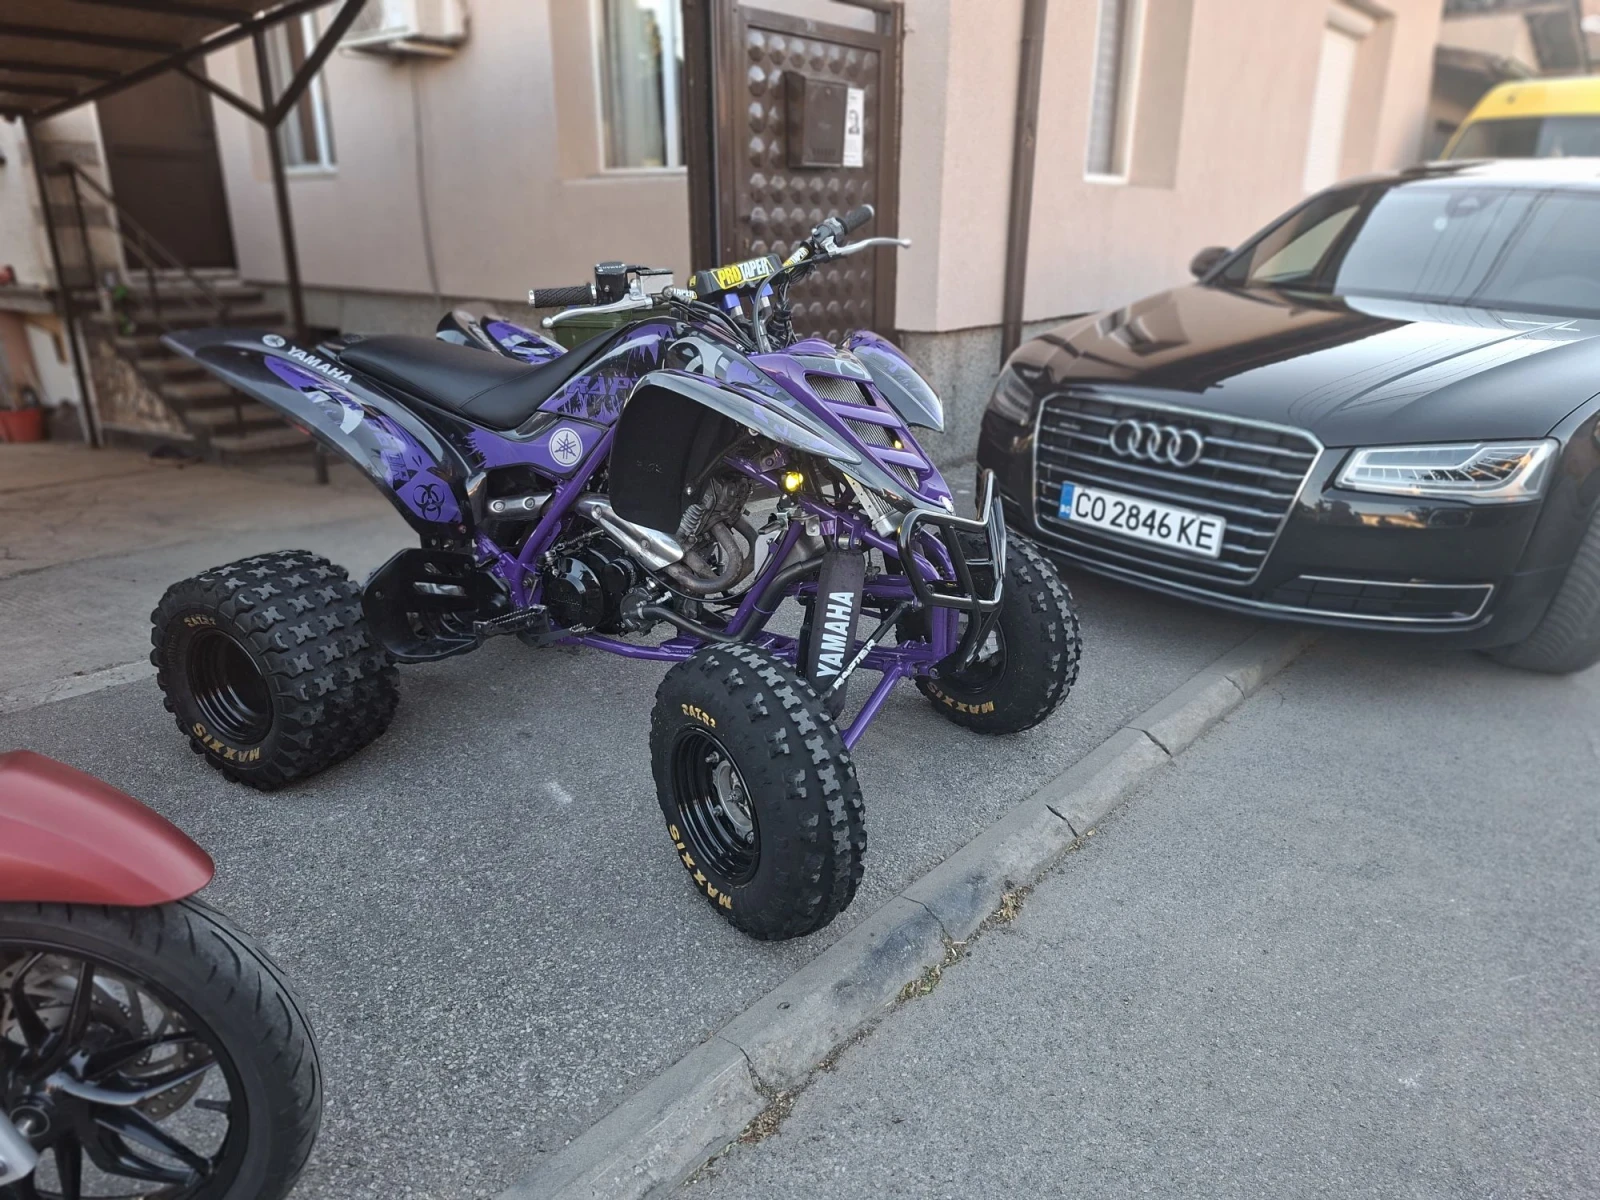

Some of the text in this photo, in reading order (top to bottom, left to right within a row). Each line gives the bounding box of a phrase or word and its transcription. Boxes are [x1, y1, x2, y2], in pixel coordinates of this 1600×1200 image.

[717, 257, 769, 285] PROTAPER
[287, 346, 352, 384] YAMAHA
[566, 375, 640, 395] RAP
[1075, 492, 1216, 551] CO 2846 KE
[816, 591, 855, 678] YAMAHA
[927, 681, 995, 715] MAXXIS
[192, 722, 260, 763] MAXXIS
[669, 823, 733, 910] MAXXIS
